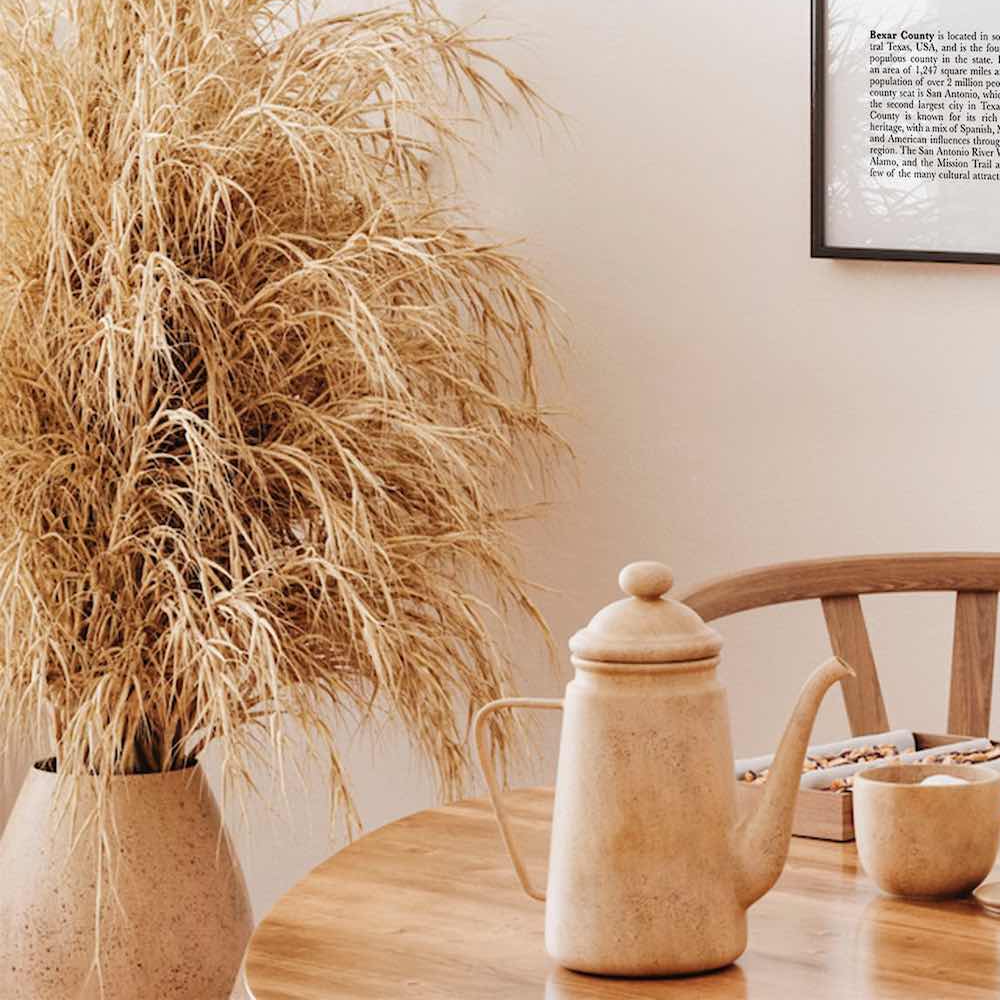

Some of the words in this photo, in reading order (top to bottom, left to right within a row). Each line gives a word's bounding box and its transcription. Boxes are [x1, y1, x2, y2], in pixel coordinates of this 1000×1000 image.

[869, 30, 898, 40] Bexar
[900, 30, 935, 42] County
[937, 31, 945, 40] is
[947, 31, 977, 41] located
[980, 31, 989, 41] in
[869, 42, 884, 51] tral
[886, 42, 913, 53] Texas,
[916, 42, 939, 53] USA,
[941, 42, 957, 52] and
[959, 42, 967, 52] is
[969, 43, 983, 52] the
[902, 65, 912, 75] of
[916, 65, 938, 76] 1,247
[941, 68, 968, 78] square
[970, 66, 992, 76] miles
[869, 89, 897, 100] county
[899, 89, 915, 98] seat
[917, 88, 924, 98] is
[926, 88, 942, 98] San
[944, 89, 980, 100] Antonio,
[869, 111, 900, 123] County
[905, 111, 912, 121] is
[916, 111, 944, 121] known
[949, 112, 961, 122] for
[966, 112, 977, 122] its
[981, 113, 998, 122] rich
[869, 145, 898, 158] region.
[900, 146, 917, 156] The
[919, 146, 934, 156] San
[936, 147, 970, 157] Antonio
[971, 147, 994, 157] River
[870, 168, 884, 178] few
[886, 169, 895, 178] of
[898, 169, 911, 179] the
[914, 172, 937, 182] many
[938, 170, 970, 180] cultural
